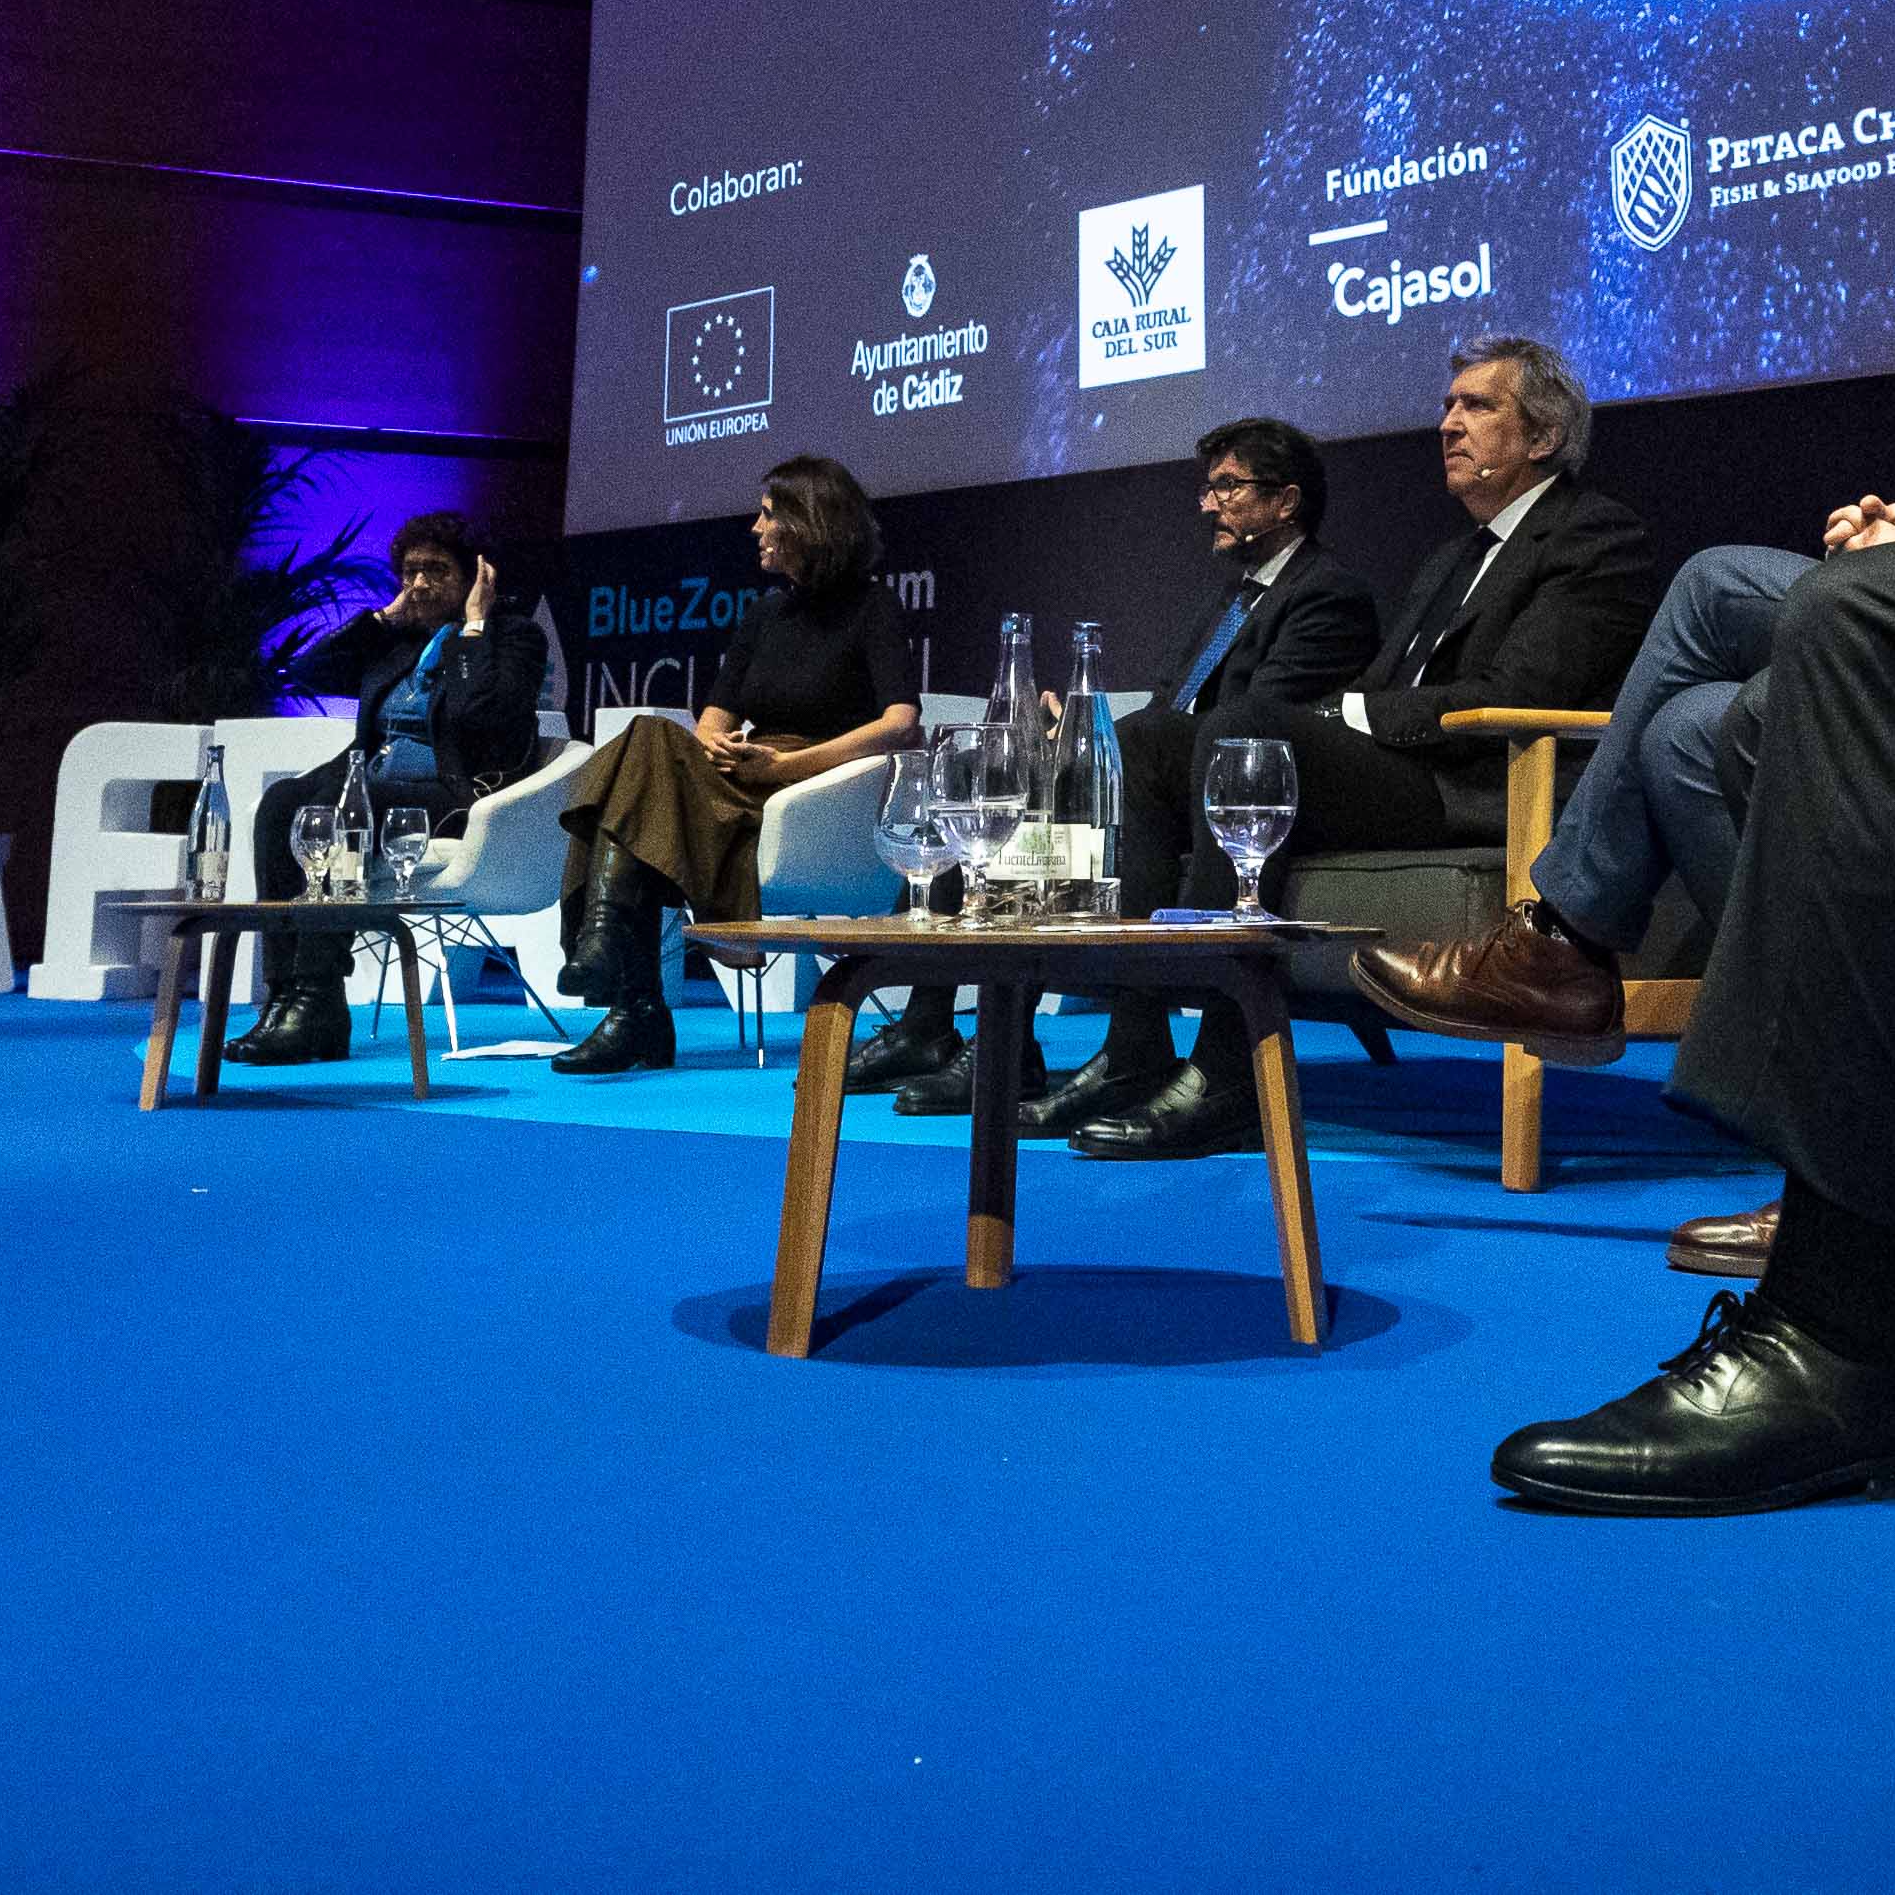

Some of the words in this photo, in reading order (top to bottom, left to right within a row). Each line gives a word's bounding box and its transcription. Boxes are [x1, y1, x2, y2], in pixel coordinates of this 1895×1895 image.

[670, 159, 804, 216] Colaboran:
[1325, 142, 1489, 202] Fundación
[1763, 179, 1780, 198] &
[1330, 243, 1492, 325] Cajasol
[1135, 306, 1192, 331] RURAL
[851, 319, 988, 381] Ayuntamiento
[1105, 338, 1138, 358] DEL
[1143, 330, 1177, 352] SUR
[873, 380, 898, 416] de
[903, 368, 963, 411] Cádiz
[665, 420, 707, 446] UNIÓN
[709, 411, 769, 439] EUROPEA
